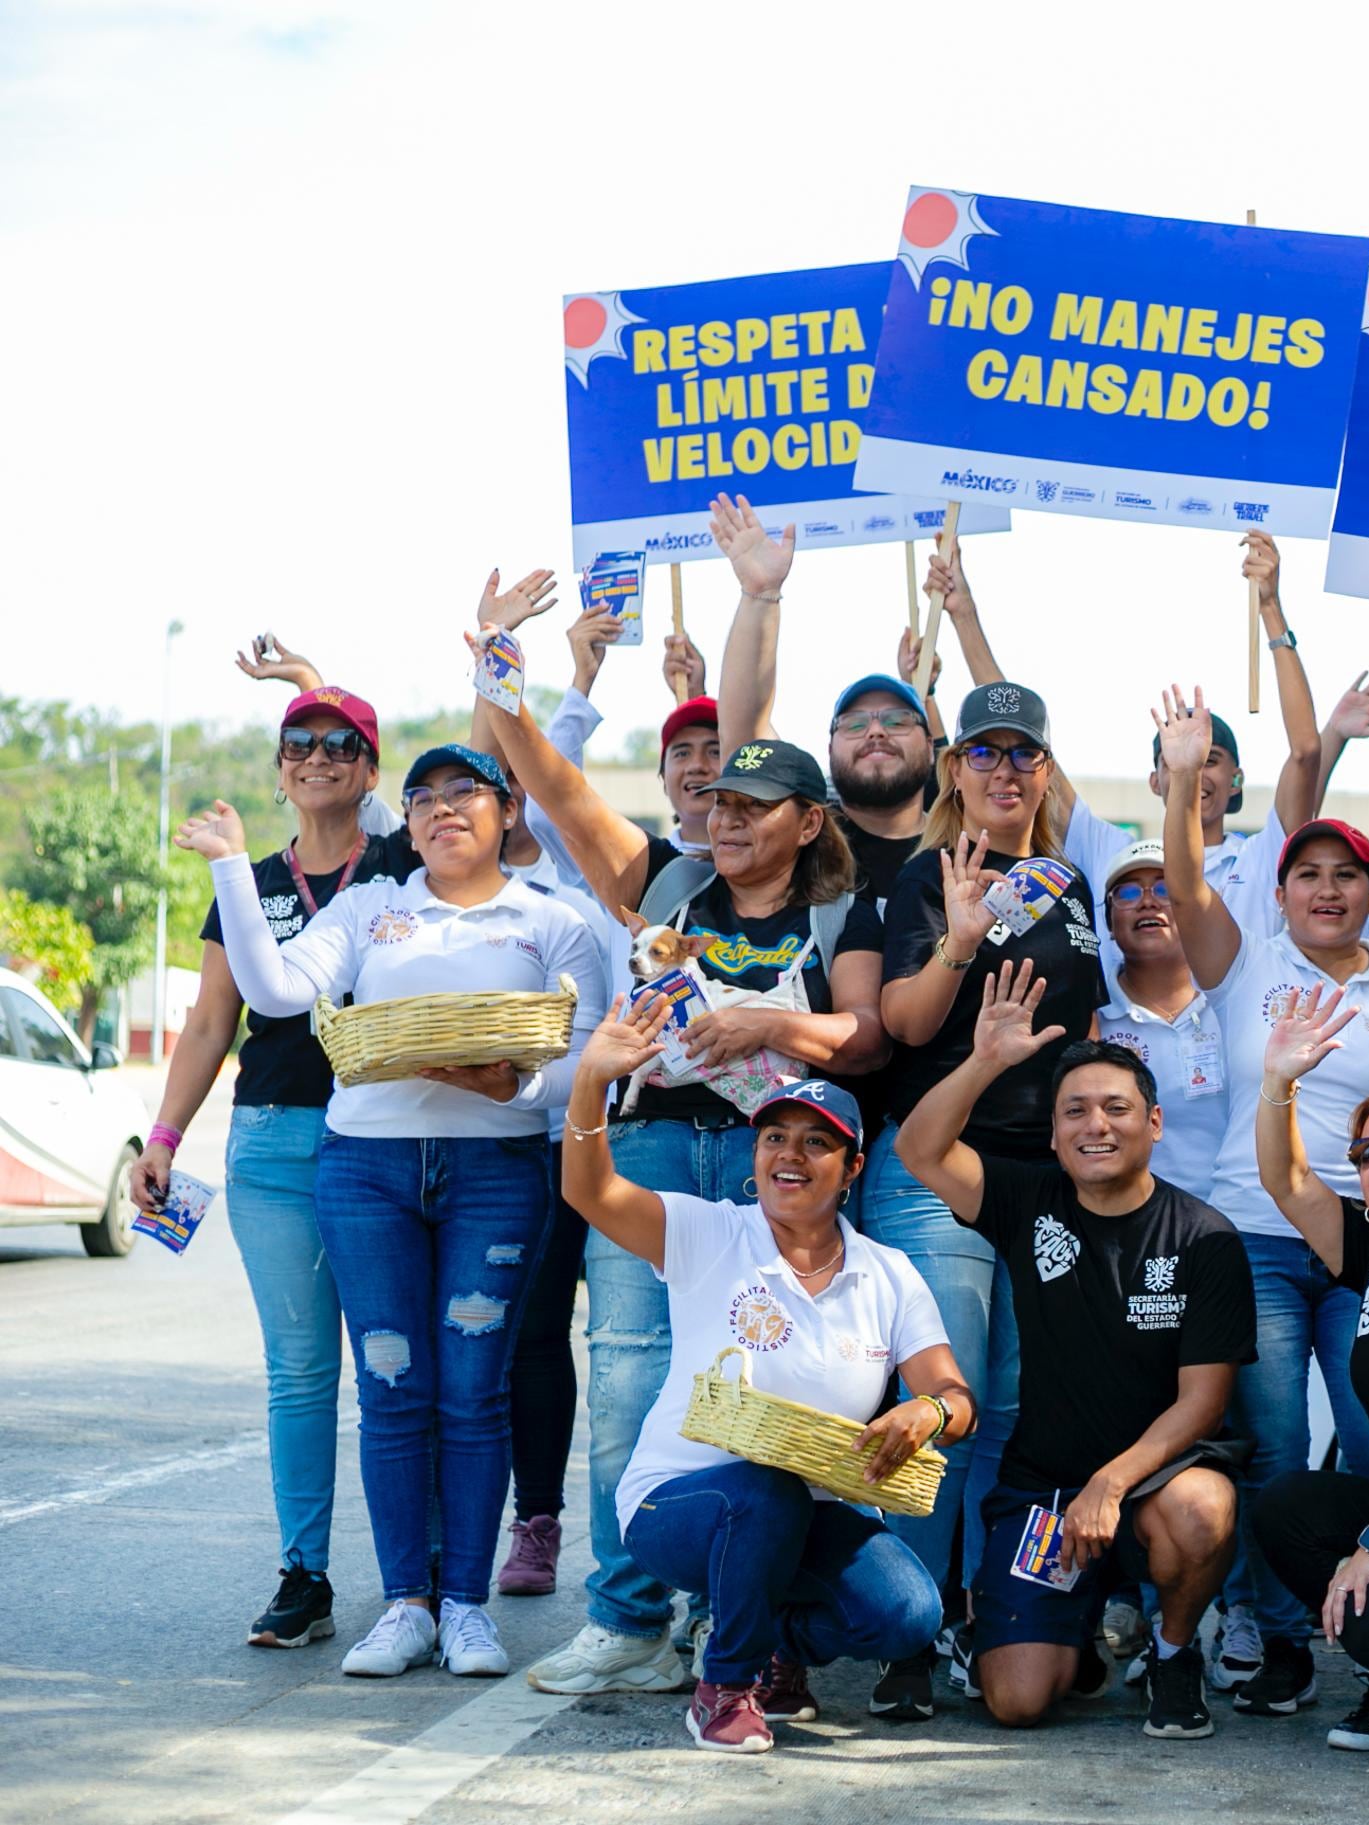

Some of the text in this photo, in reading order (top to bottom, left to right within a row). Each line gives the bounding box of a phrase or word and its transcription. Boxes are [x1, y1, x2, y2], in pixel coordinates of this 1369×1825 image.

[634, 308, 865, 373] RESPETA
[930, 277, 1324, 368] ¡NO MANEJES
[657, 362, 875, 427] LÍMITE D
[967, 350, 1270, 429] CANSADO!
[644, 420, 862, 482] VELOCID
[1131, 844, 1164, 854] MYKON
[1262, 983, 1313, 1016] FACILITADO
[730, 1286, 775, 1326] FACILITA
[1126, 1314, 1177, 1323] DEL ESTADO
[1128, 1293, 1177, 1303] SECRETARÍA
